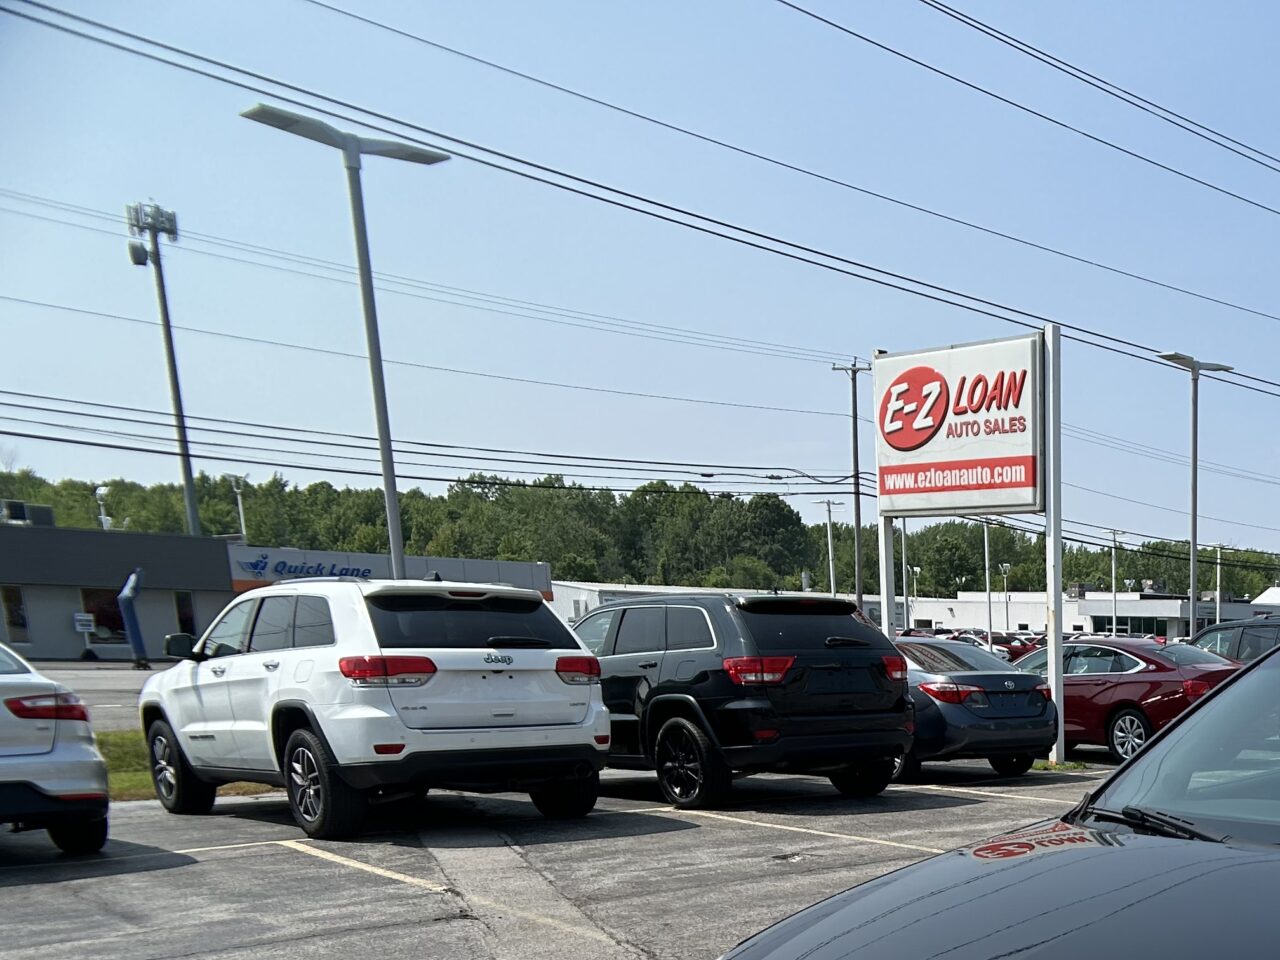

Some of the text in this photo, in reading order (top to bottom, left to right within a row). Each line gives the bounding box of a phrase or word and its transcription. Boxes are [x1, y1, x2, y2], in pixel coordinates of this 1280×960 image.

[884, 368, 1028, 435] E-Z LOAN
[946, 416, 1027, 439] AUTO SALES
[884, 464, 1026, 490] www.ezloanauto.com
[273, 560, 372, 577] Quick Lane
[483, 653, 514, 665] Jeep
